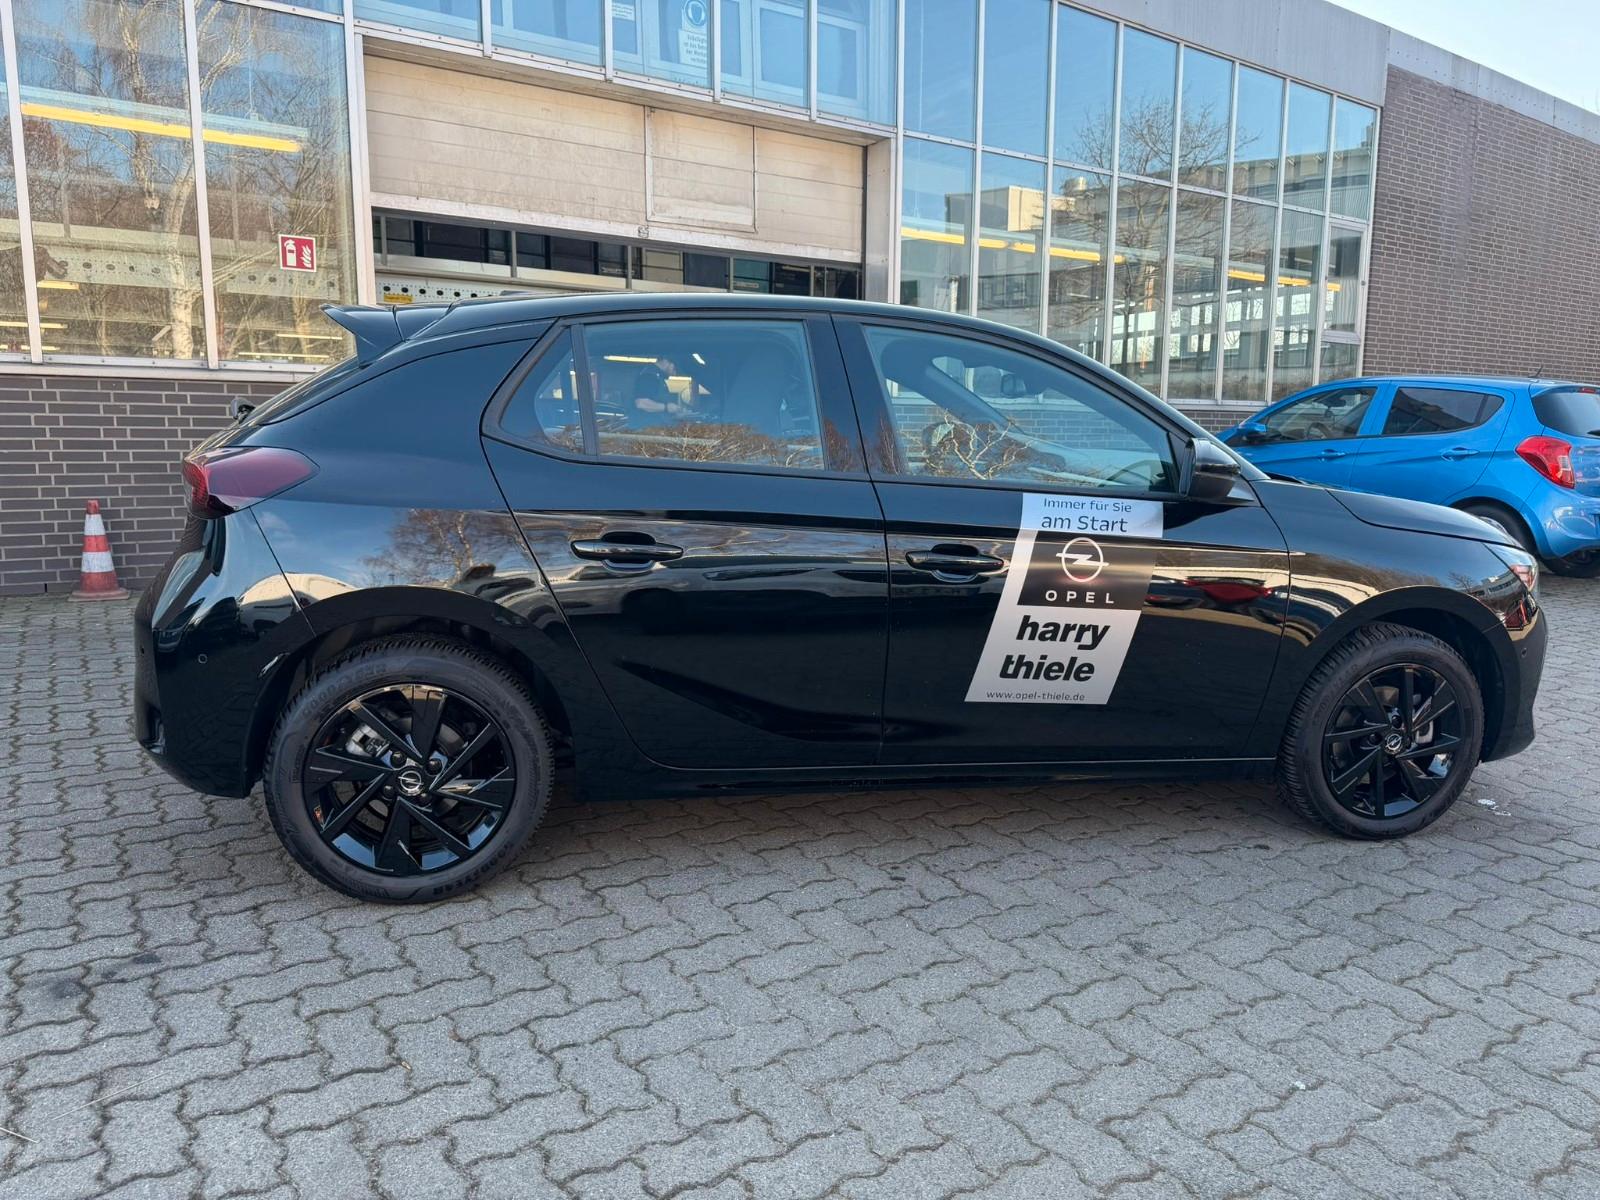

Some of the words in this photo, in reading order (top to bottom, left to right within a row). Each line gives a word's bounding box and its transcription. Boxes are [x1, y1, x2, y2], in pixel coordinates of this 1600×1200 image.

[1044, 498, 1086, 510] Immer
[1090, 500, 1109, 512] für
[1113, 502, 1132, 513] Sie
[1042, 516, 1071, 529] am
[1077, 515, 1128, 533] Start
[1045, 590, 1114, 604] OPEL
[1016, 614, 1110, 650] harry
[999, 654, 1095, 682] thiele
[986, 691, 1085, 701] www.opel-thiele.de
